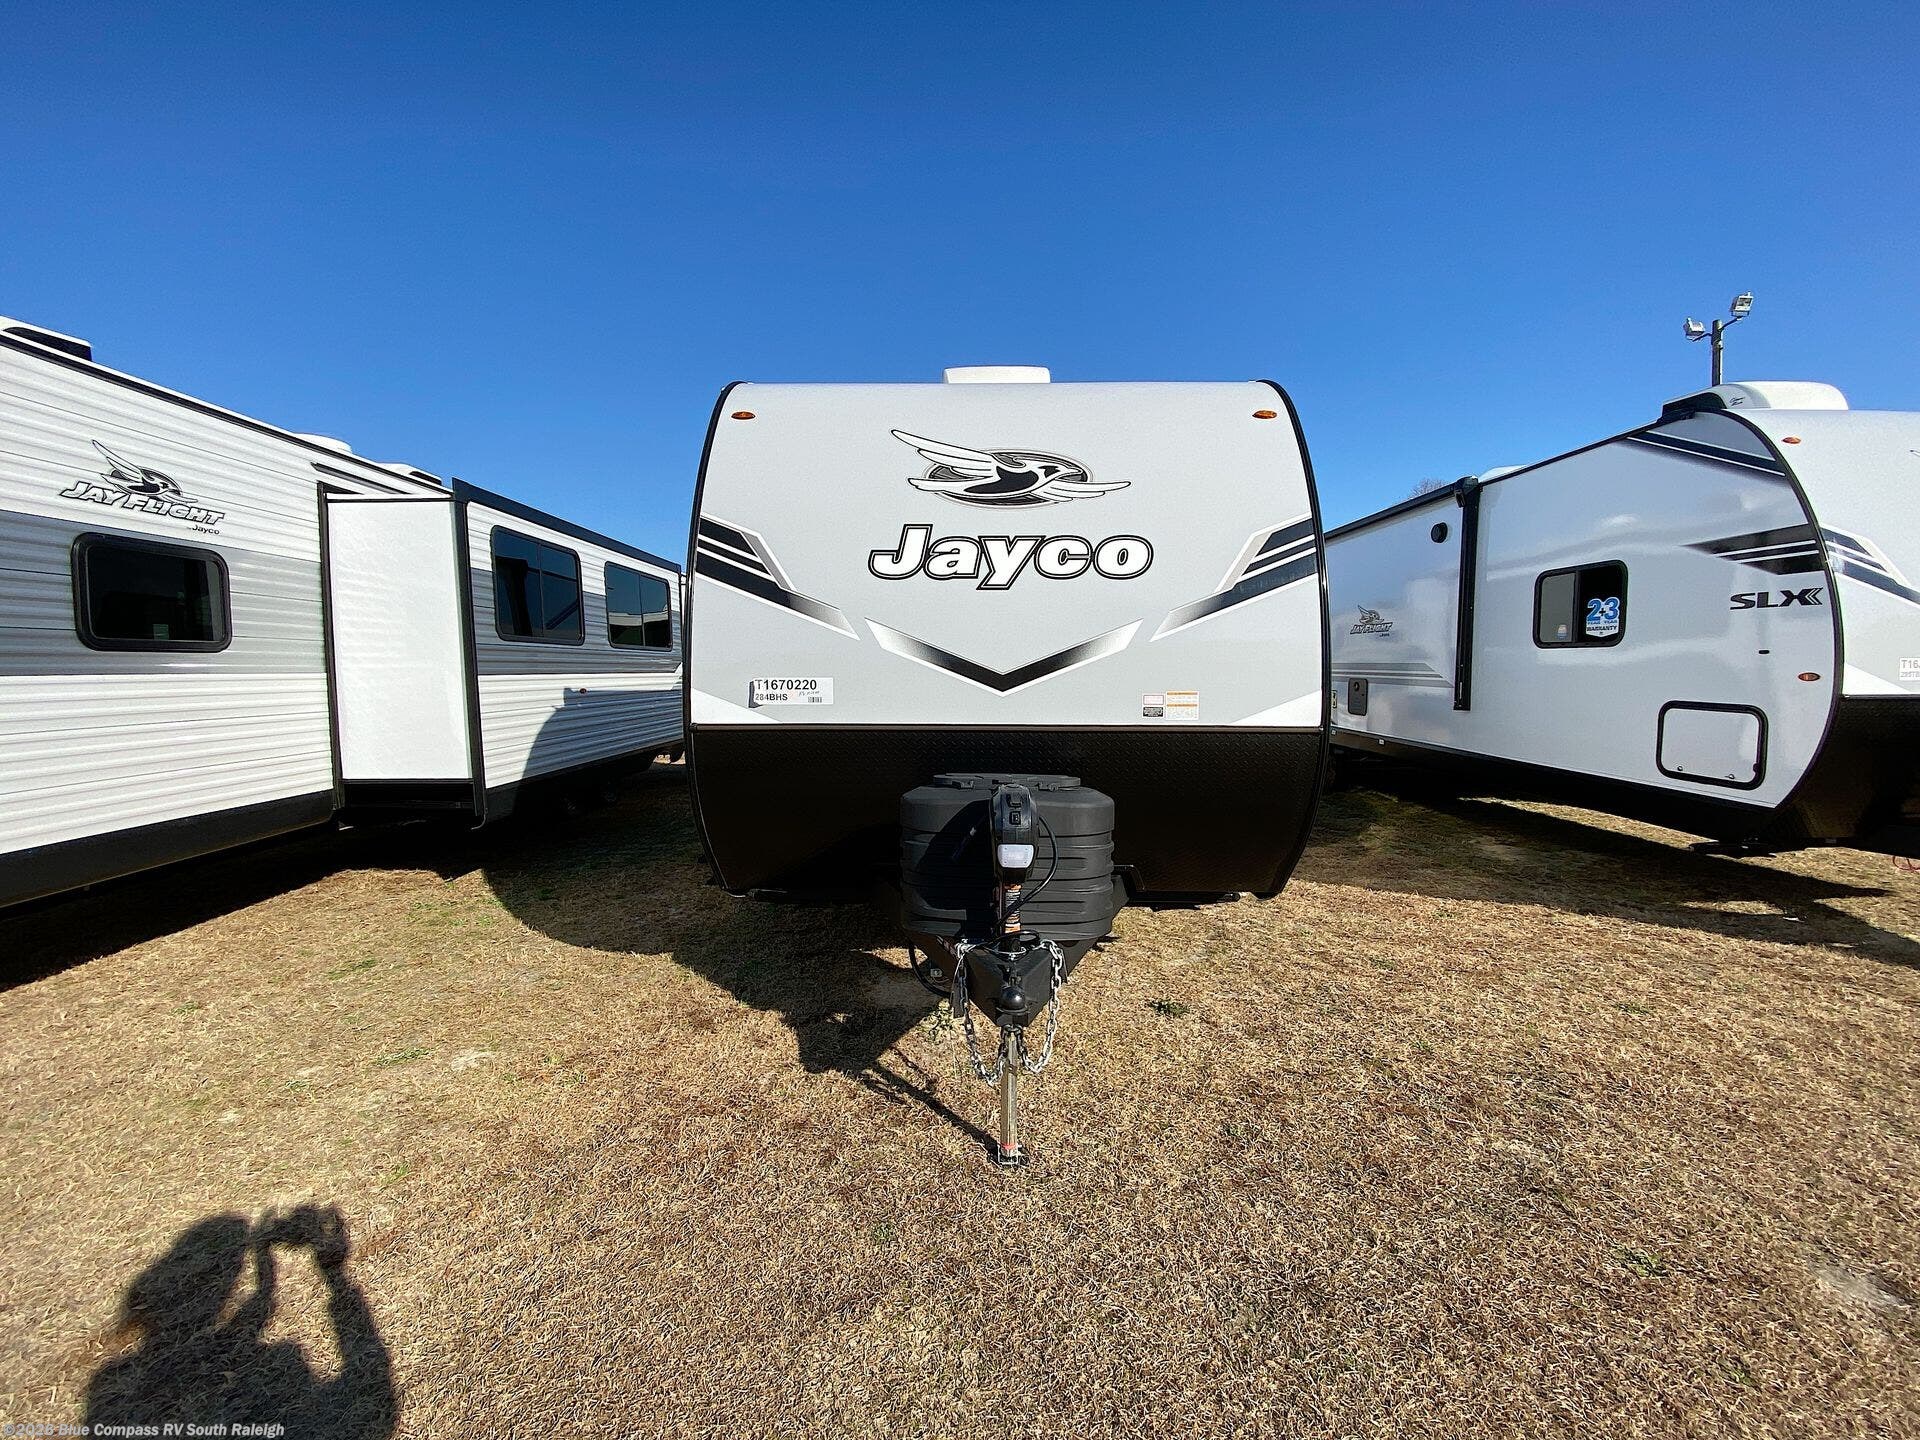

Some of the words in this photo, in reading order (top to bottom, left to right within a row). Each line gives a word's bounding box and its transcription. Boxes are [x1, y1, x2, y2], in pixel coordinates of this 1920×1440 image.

[59, 480, 127, 505] JAY
[122, 493, 226, 525] FLIGHT
[192, 524, 221, 536] Jayco
[868, 524, 1153, 590] Jayco
[1730, 587, 1823, 611] SLX
[1350, 624, 1364, 635] JAY
[1363, 622, 1394, 634] FLIGHT
[1901, 660, 1920, 669] T16
[755, 679, 817, 690] T1670220
[755, 693, 788, 701] 284BHS
